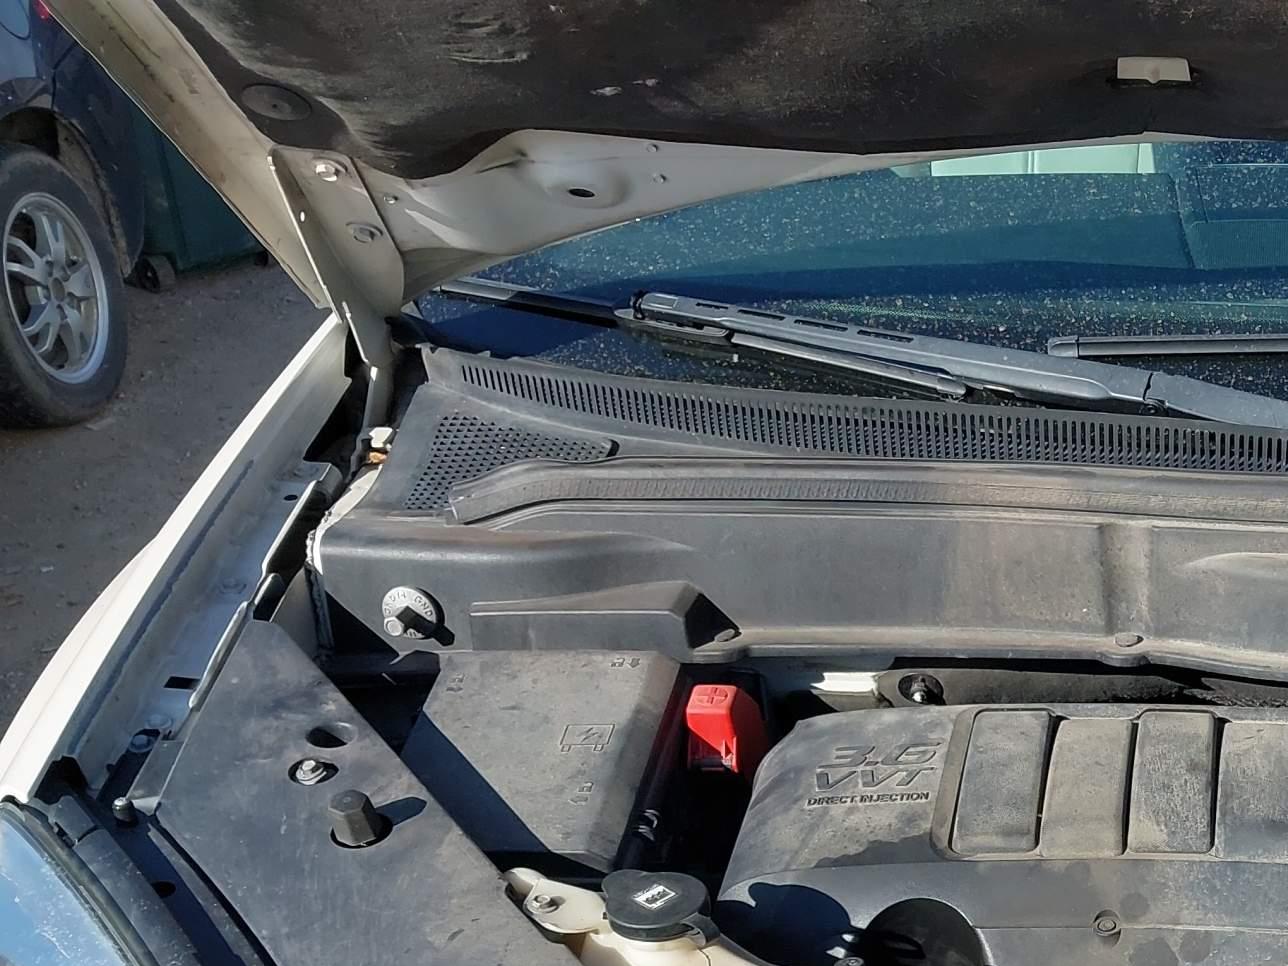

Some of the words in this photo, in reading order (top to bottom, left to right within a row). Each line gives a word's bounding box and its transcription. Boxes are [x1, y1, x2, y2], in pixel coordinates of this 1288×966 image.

[817, 740, 943, 768] 3.6
[815, 767, 937, 791] VVT
[807, 794, 857, 806] DIRECT
[858, 791, 931, 805] INJECTION
